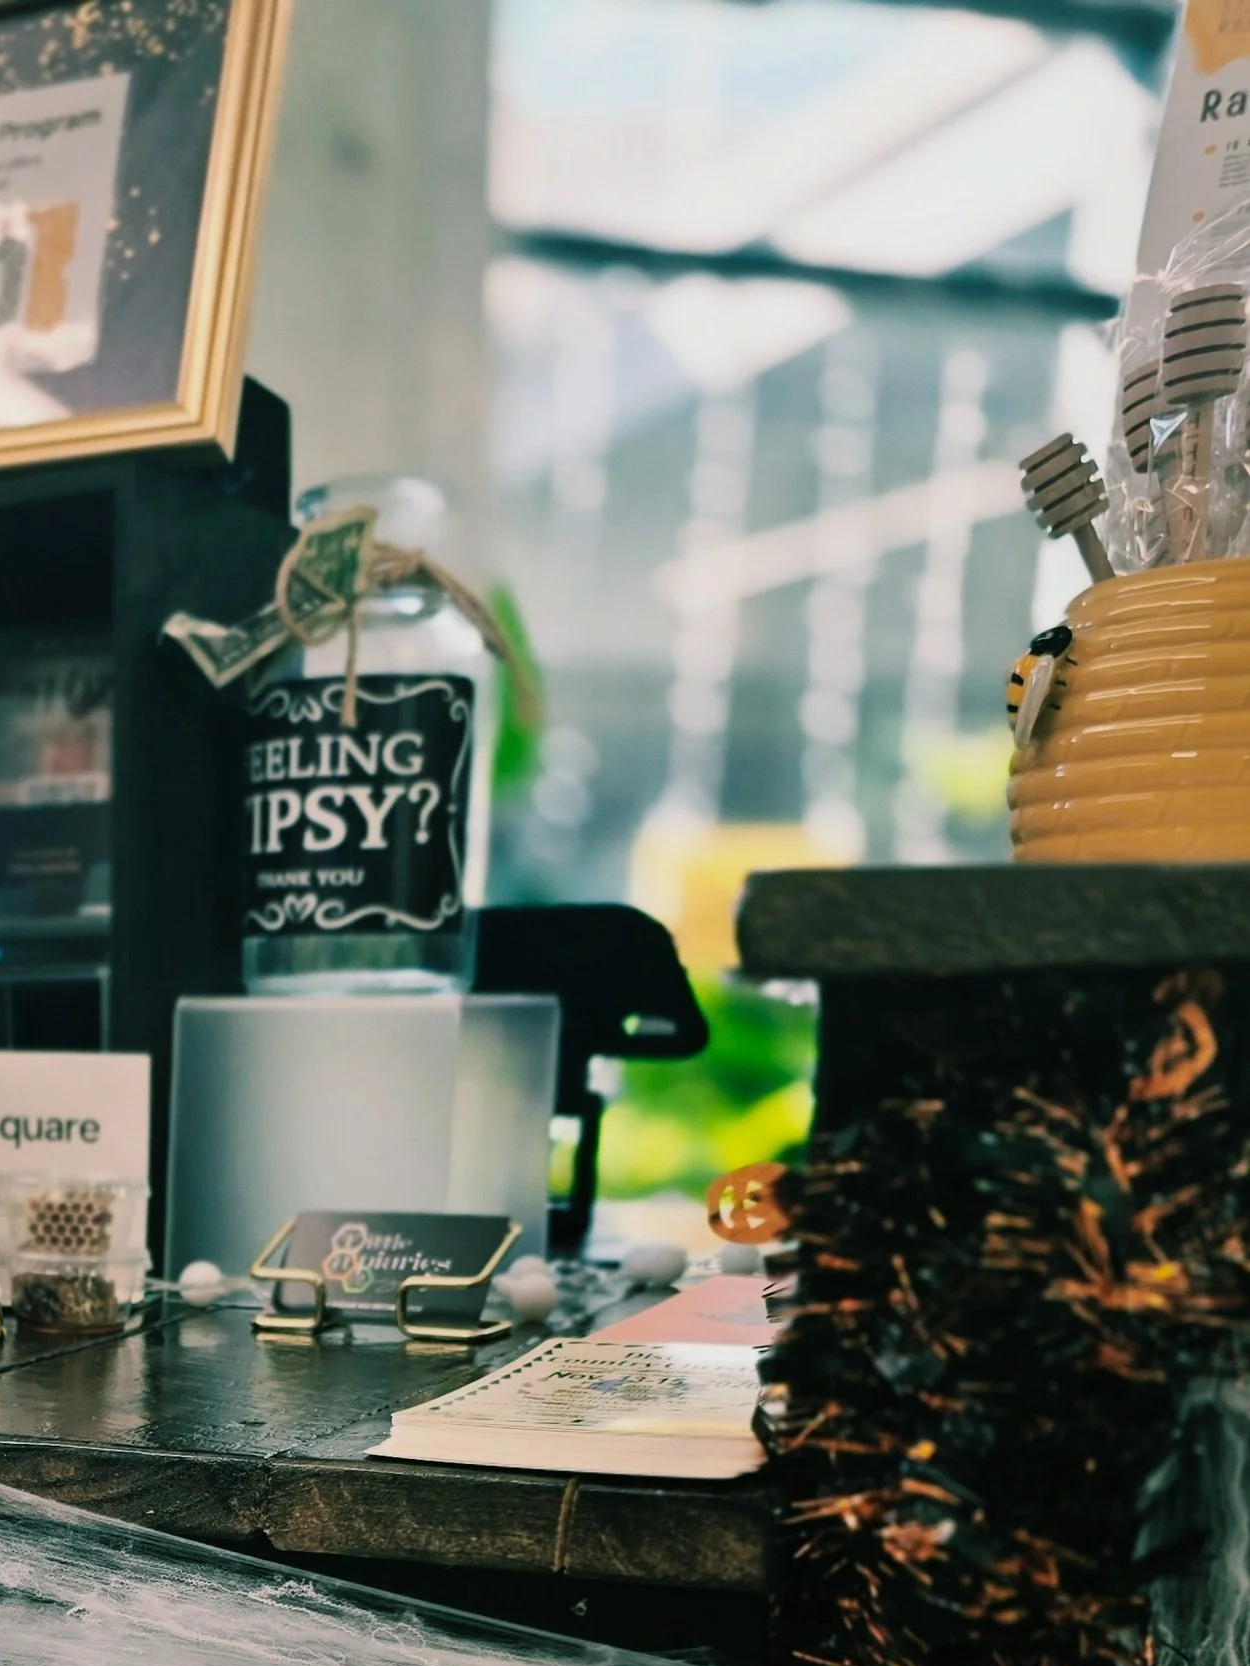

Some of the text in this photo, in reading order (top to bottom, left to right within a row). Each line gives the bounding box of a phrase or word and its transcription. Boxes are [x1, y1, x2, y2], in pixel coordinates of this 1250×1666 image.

[1199, 89, 1248, 122] Ra
[248, 731, 425, 783] EELING
[247, 780, 441, 854] IPSY?
[316, 867, 366, 887] YOU
